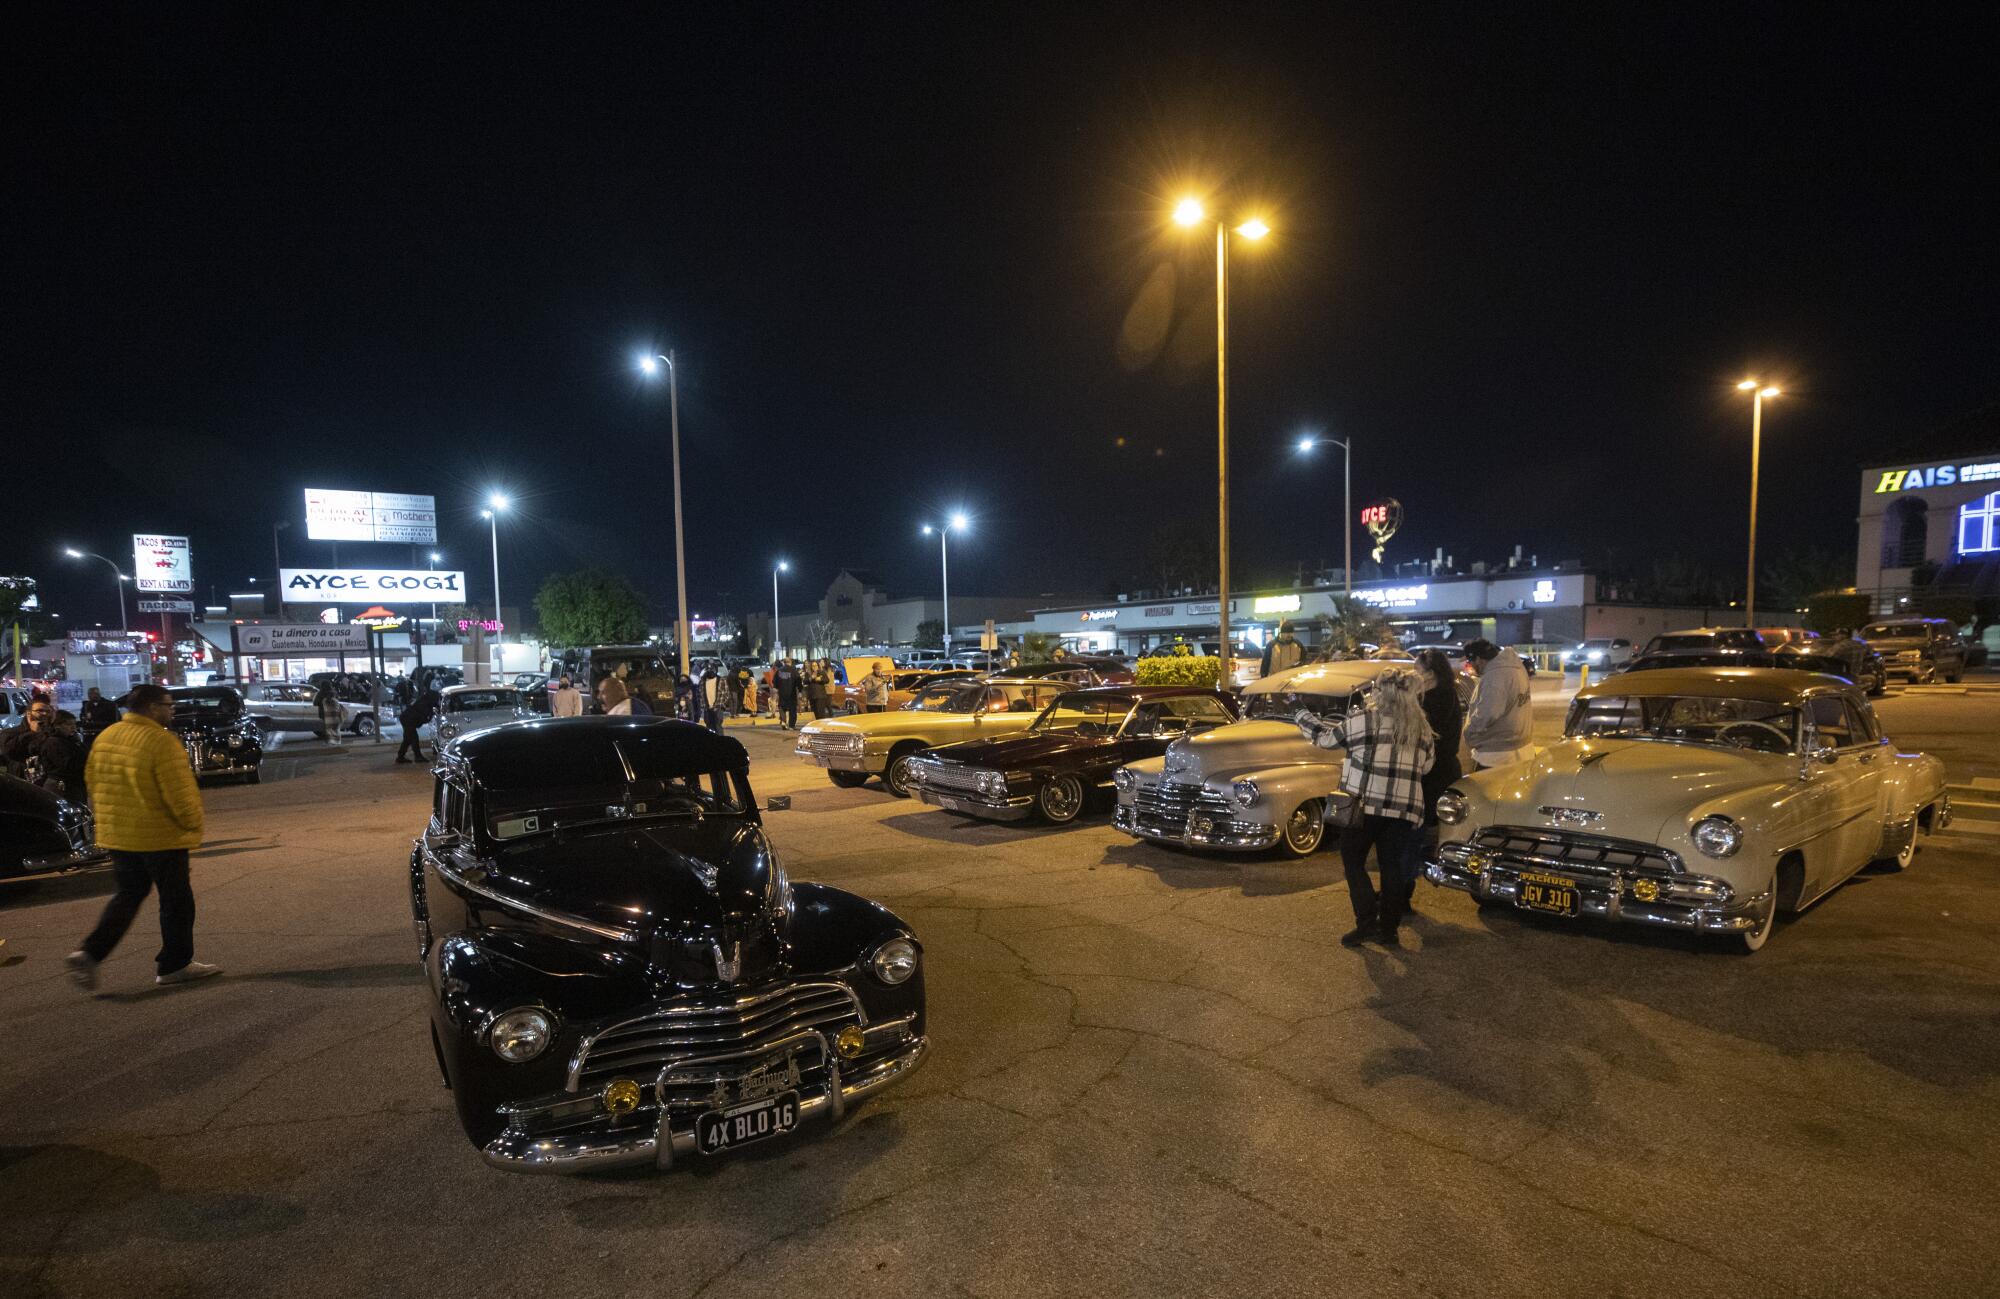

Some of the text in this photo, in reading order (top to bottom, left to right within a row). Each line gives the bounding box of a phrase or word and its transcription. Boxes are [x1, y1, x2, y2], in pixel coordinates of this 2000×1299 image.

[1874, 465, 1956, 493] HAIS
[136, 537, 159, 547] TACOS
[140, 579, 190, 590] RESTAURANTS
[289, 574, 459, 591] AYCE GOGI
[141, 601, 177, 609] TACOS
[100, 630, 126, 638] THRU
[272, 629, 284, 638] tu
[286, 628, 318, 638] dinero
[329, 628, 351, 637] casa
[271, 639, 307, 649] Guatemala,
[309, 639, 337, 649] Honduras
[340, 640, 344, 649] y
[1522, 885, 1571, 908] JGV 310
[708, 1121, 730, 1147] 4X
[772, 1104, 793, 1130] 16
